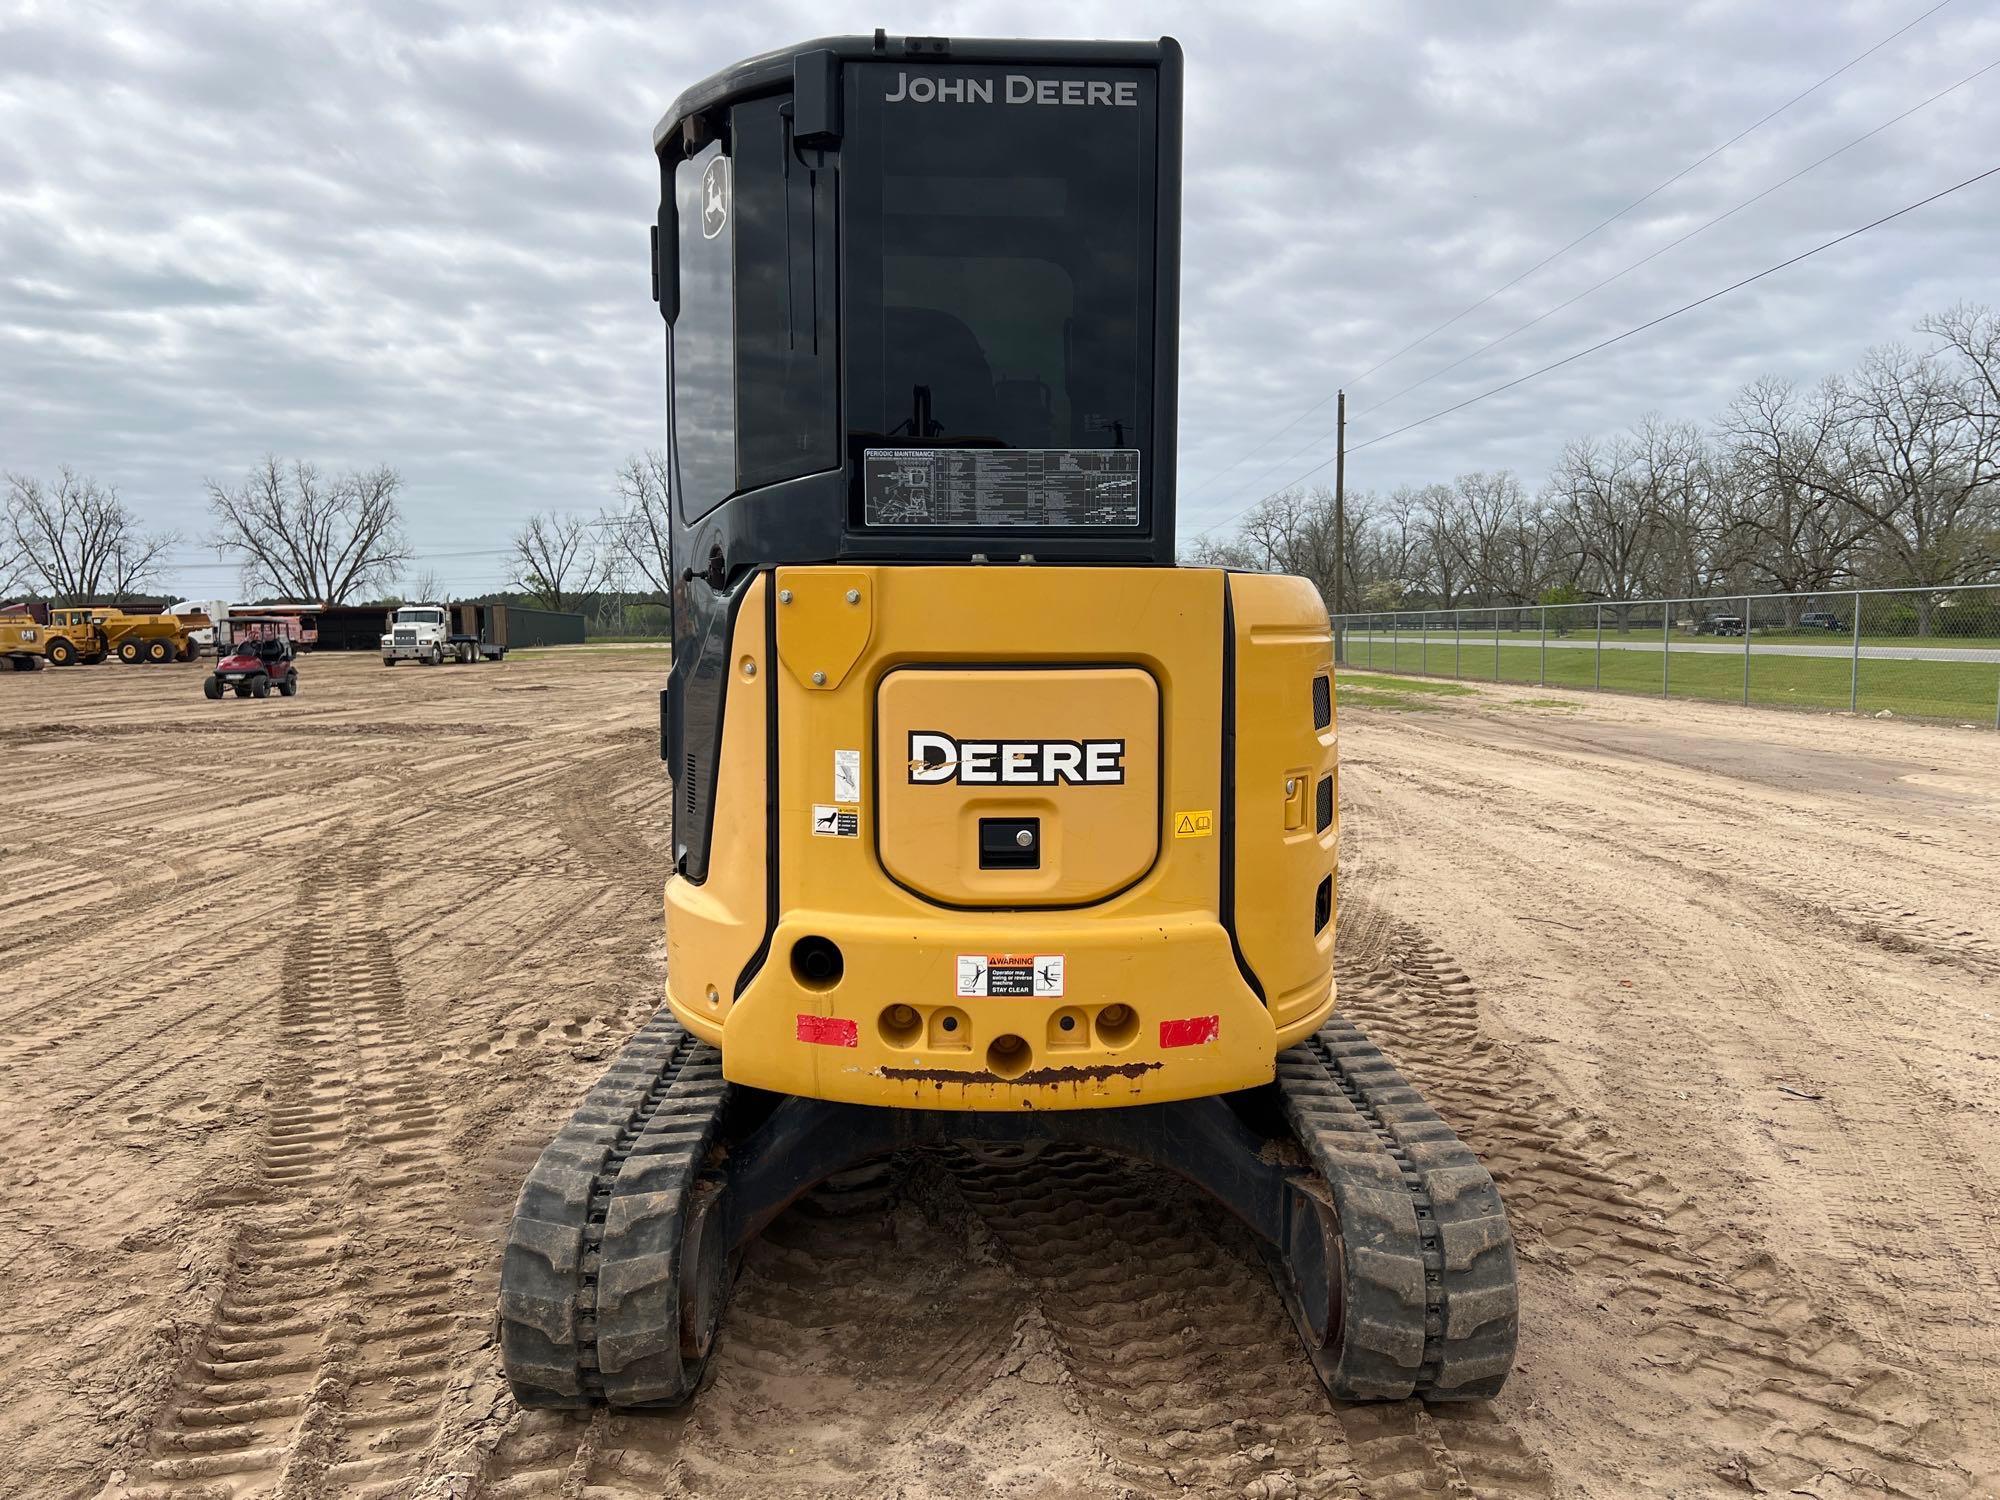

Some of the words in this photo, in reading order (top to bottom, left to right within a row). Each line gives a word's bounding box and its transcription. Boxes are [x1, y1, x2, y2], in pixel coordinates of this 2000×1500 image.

[886, 72, 993, 103] JOHN
[1006, 75, 1138, 106] DEERE
[21, 630, 34, 641] CAT
[909, 731, 1125, 785] DEERE
[997, 957, 1033, 965] WARNING
